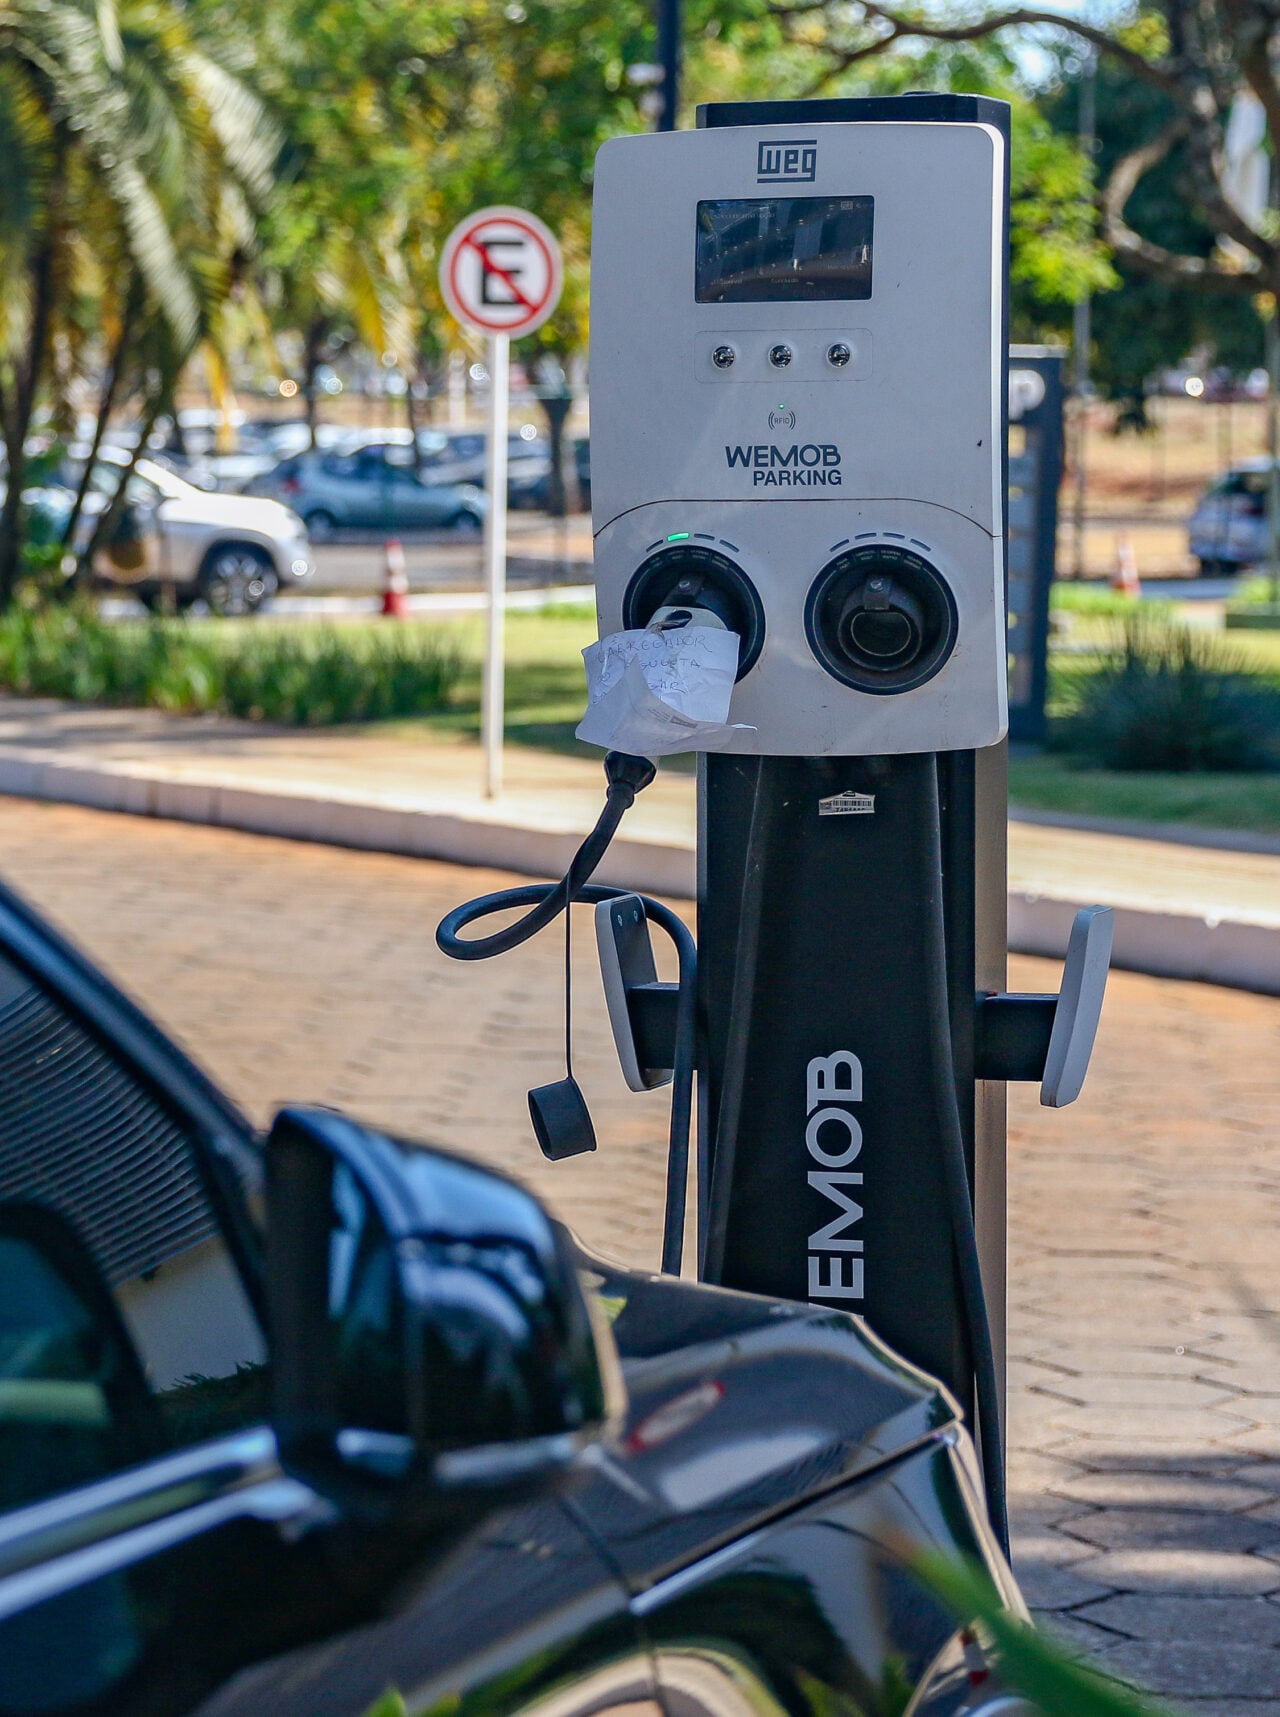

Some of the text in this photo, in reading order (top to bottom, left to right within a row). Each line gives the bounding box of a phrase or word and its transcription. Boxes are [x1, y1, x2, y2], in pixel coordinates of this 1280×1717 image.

[725, 443, 842, 468] WEMOB
[753, 469, 842, 486] PARKING
[805, 1049, 865, 1321] EMOB
